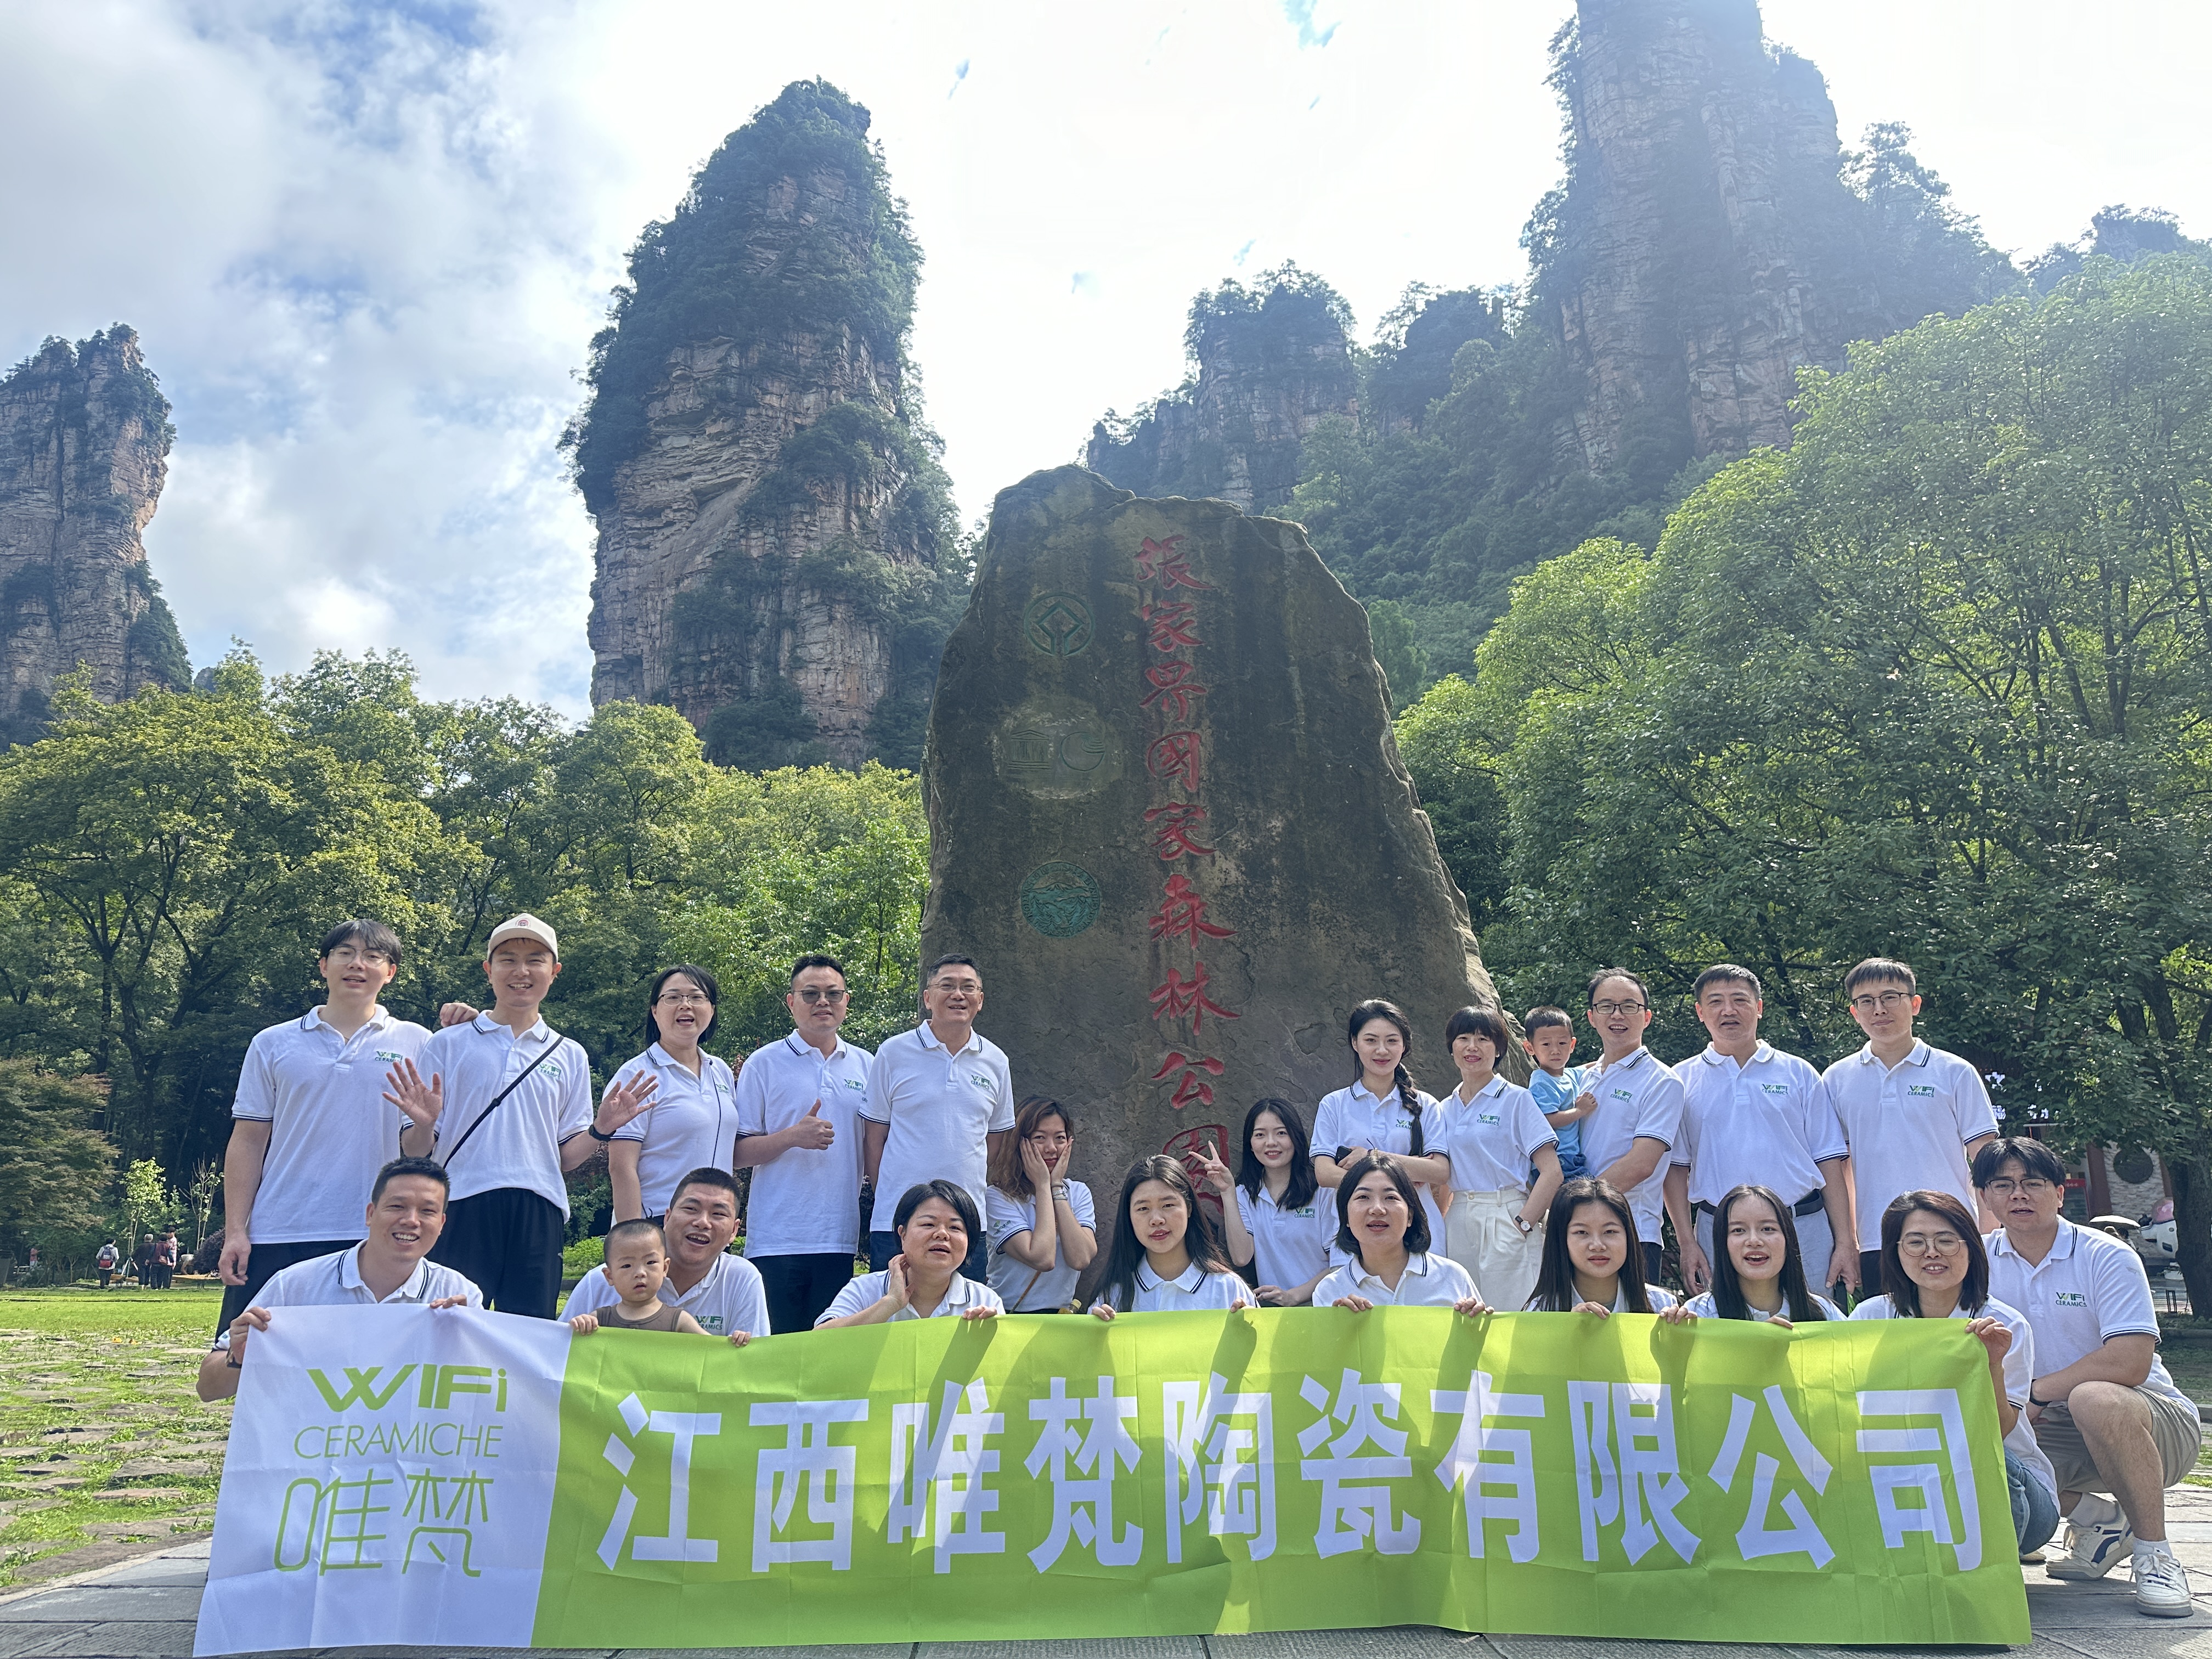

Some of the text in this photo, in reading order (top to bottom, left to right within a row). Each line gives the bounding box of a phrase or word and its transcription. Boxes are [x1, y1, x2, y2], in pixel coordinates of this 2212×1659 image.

[1610, 1093, 1630, 1103] CERAMICS
[294, 1421, 504, 1459] CERAMICHE
[596, 1367, 1982, 1574] 江西唯梵陶瓷有限公司
[274, 1468, 494, 1577] 唯梵
